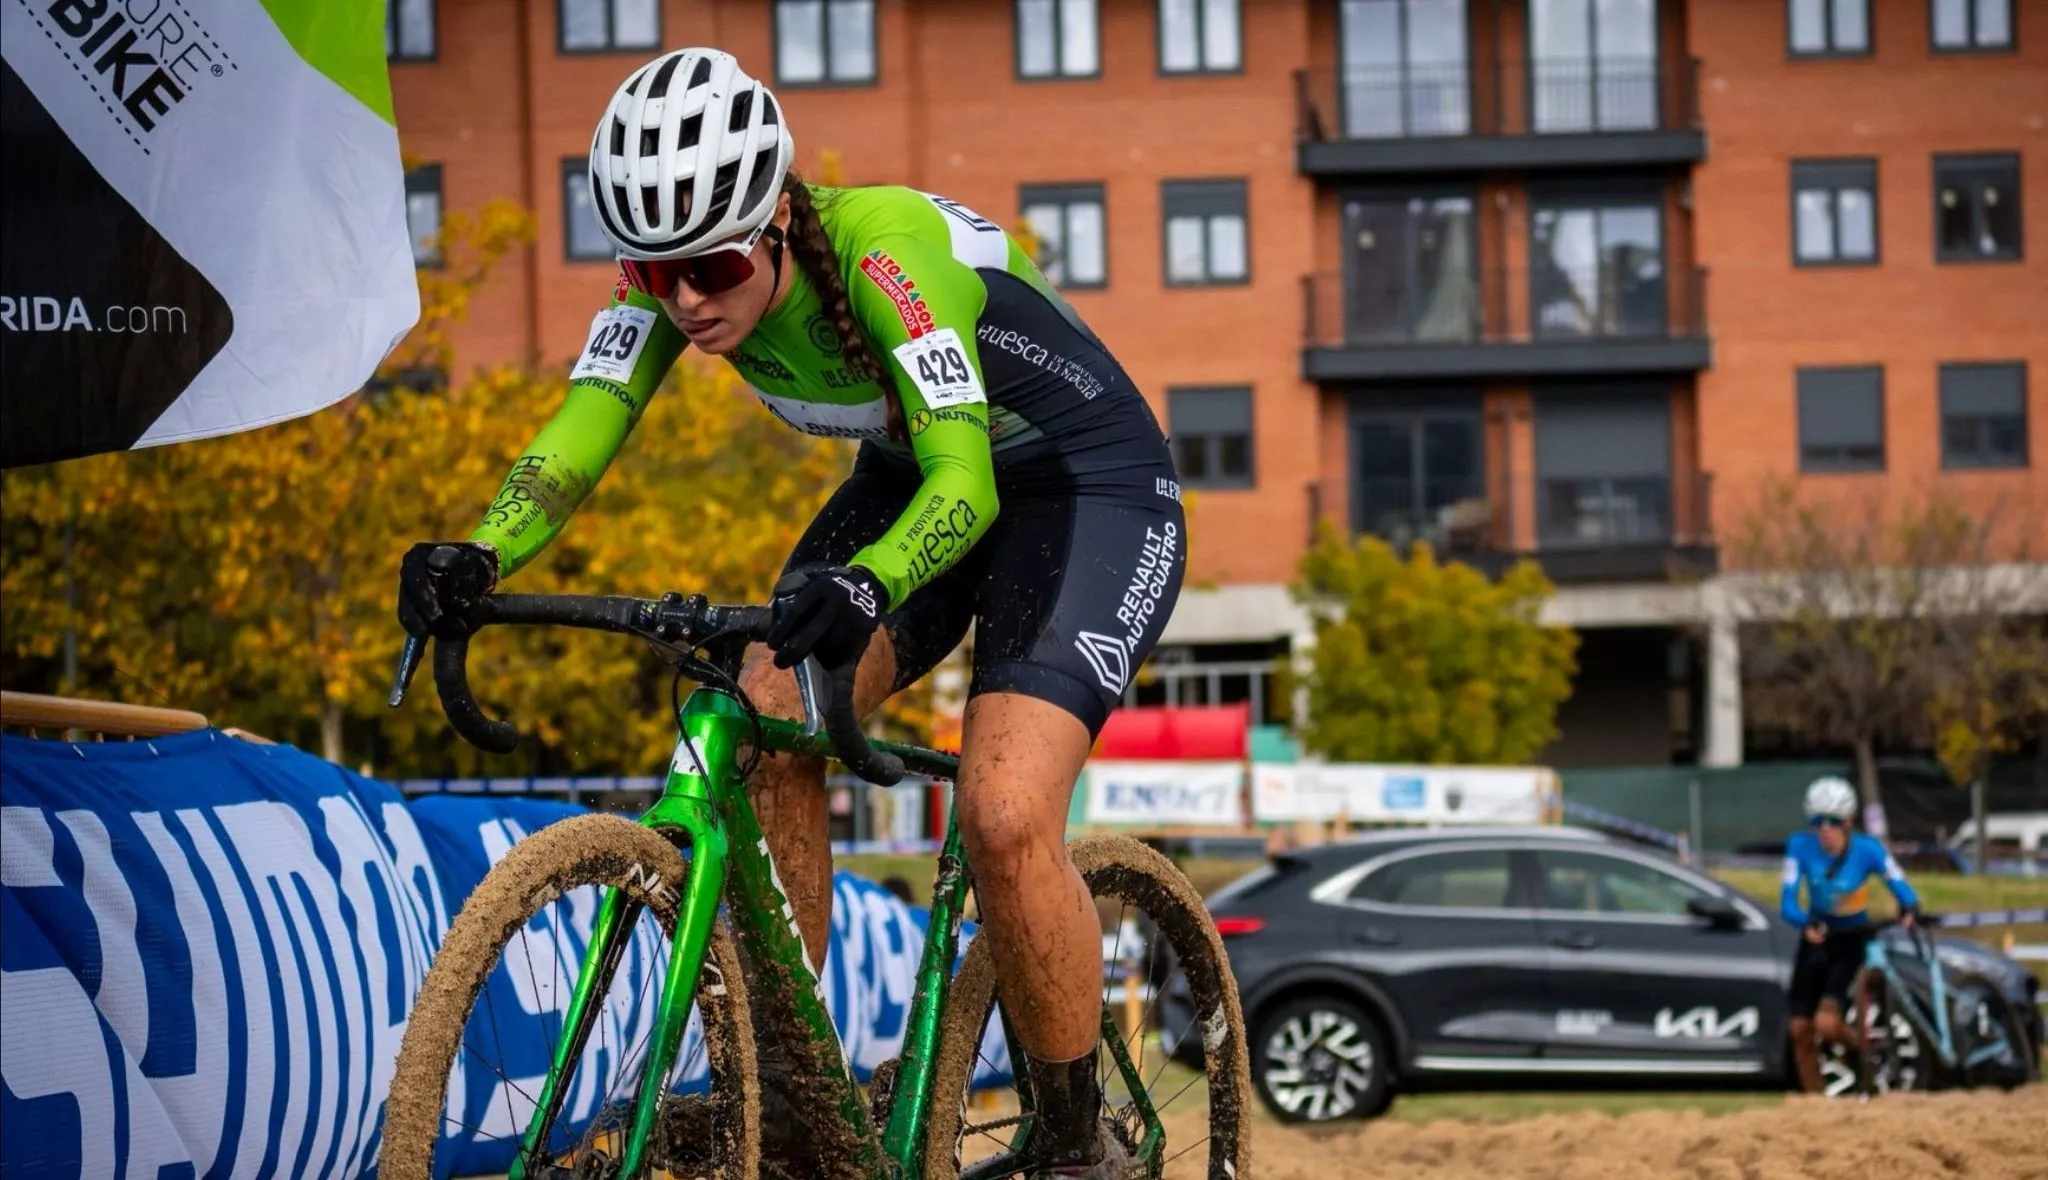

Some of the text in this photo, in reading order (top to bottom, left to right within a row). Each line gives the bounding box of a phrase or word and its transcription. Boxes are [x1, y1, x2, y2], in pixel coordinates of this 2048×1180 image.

[48, 0, 186, 133] BIKE
[866, 263, 918, 331] SUPERMERCADOS
[588, 322, 639, 361] 429
[916, 346, 971, 387] 429
[1116, 526, 1162, 627] RENAULT
[1125, 521, 1178, 654] AUTO CUATRO
